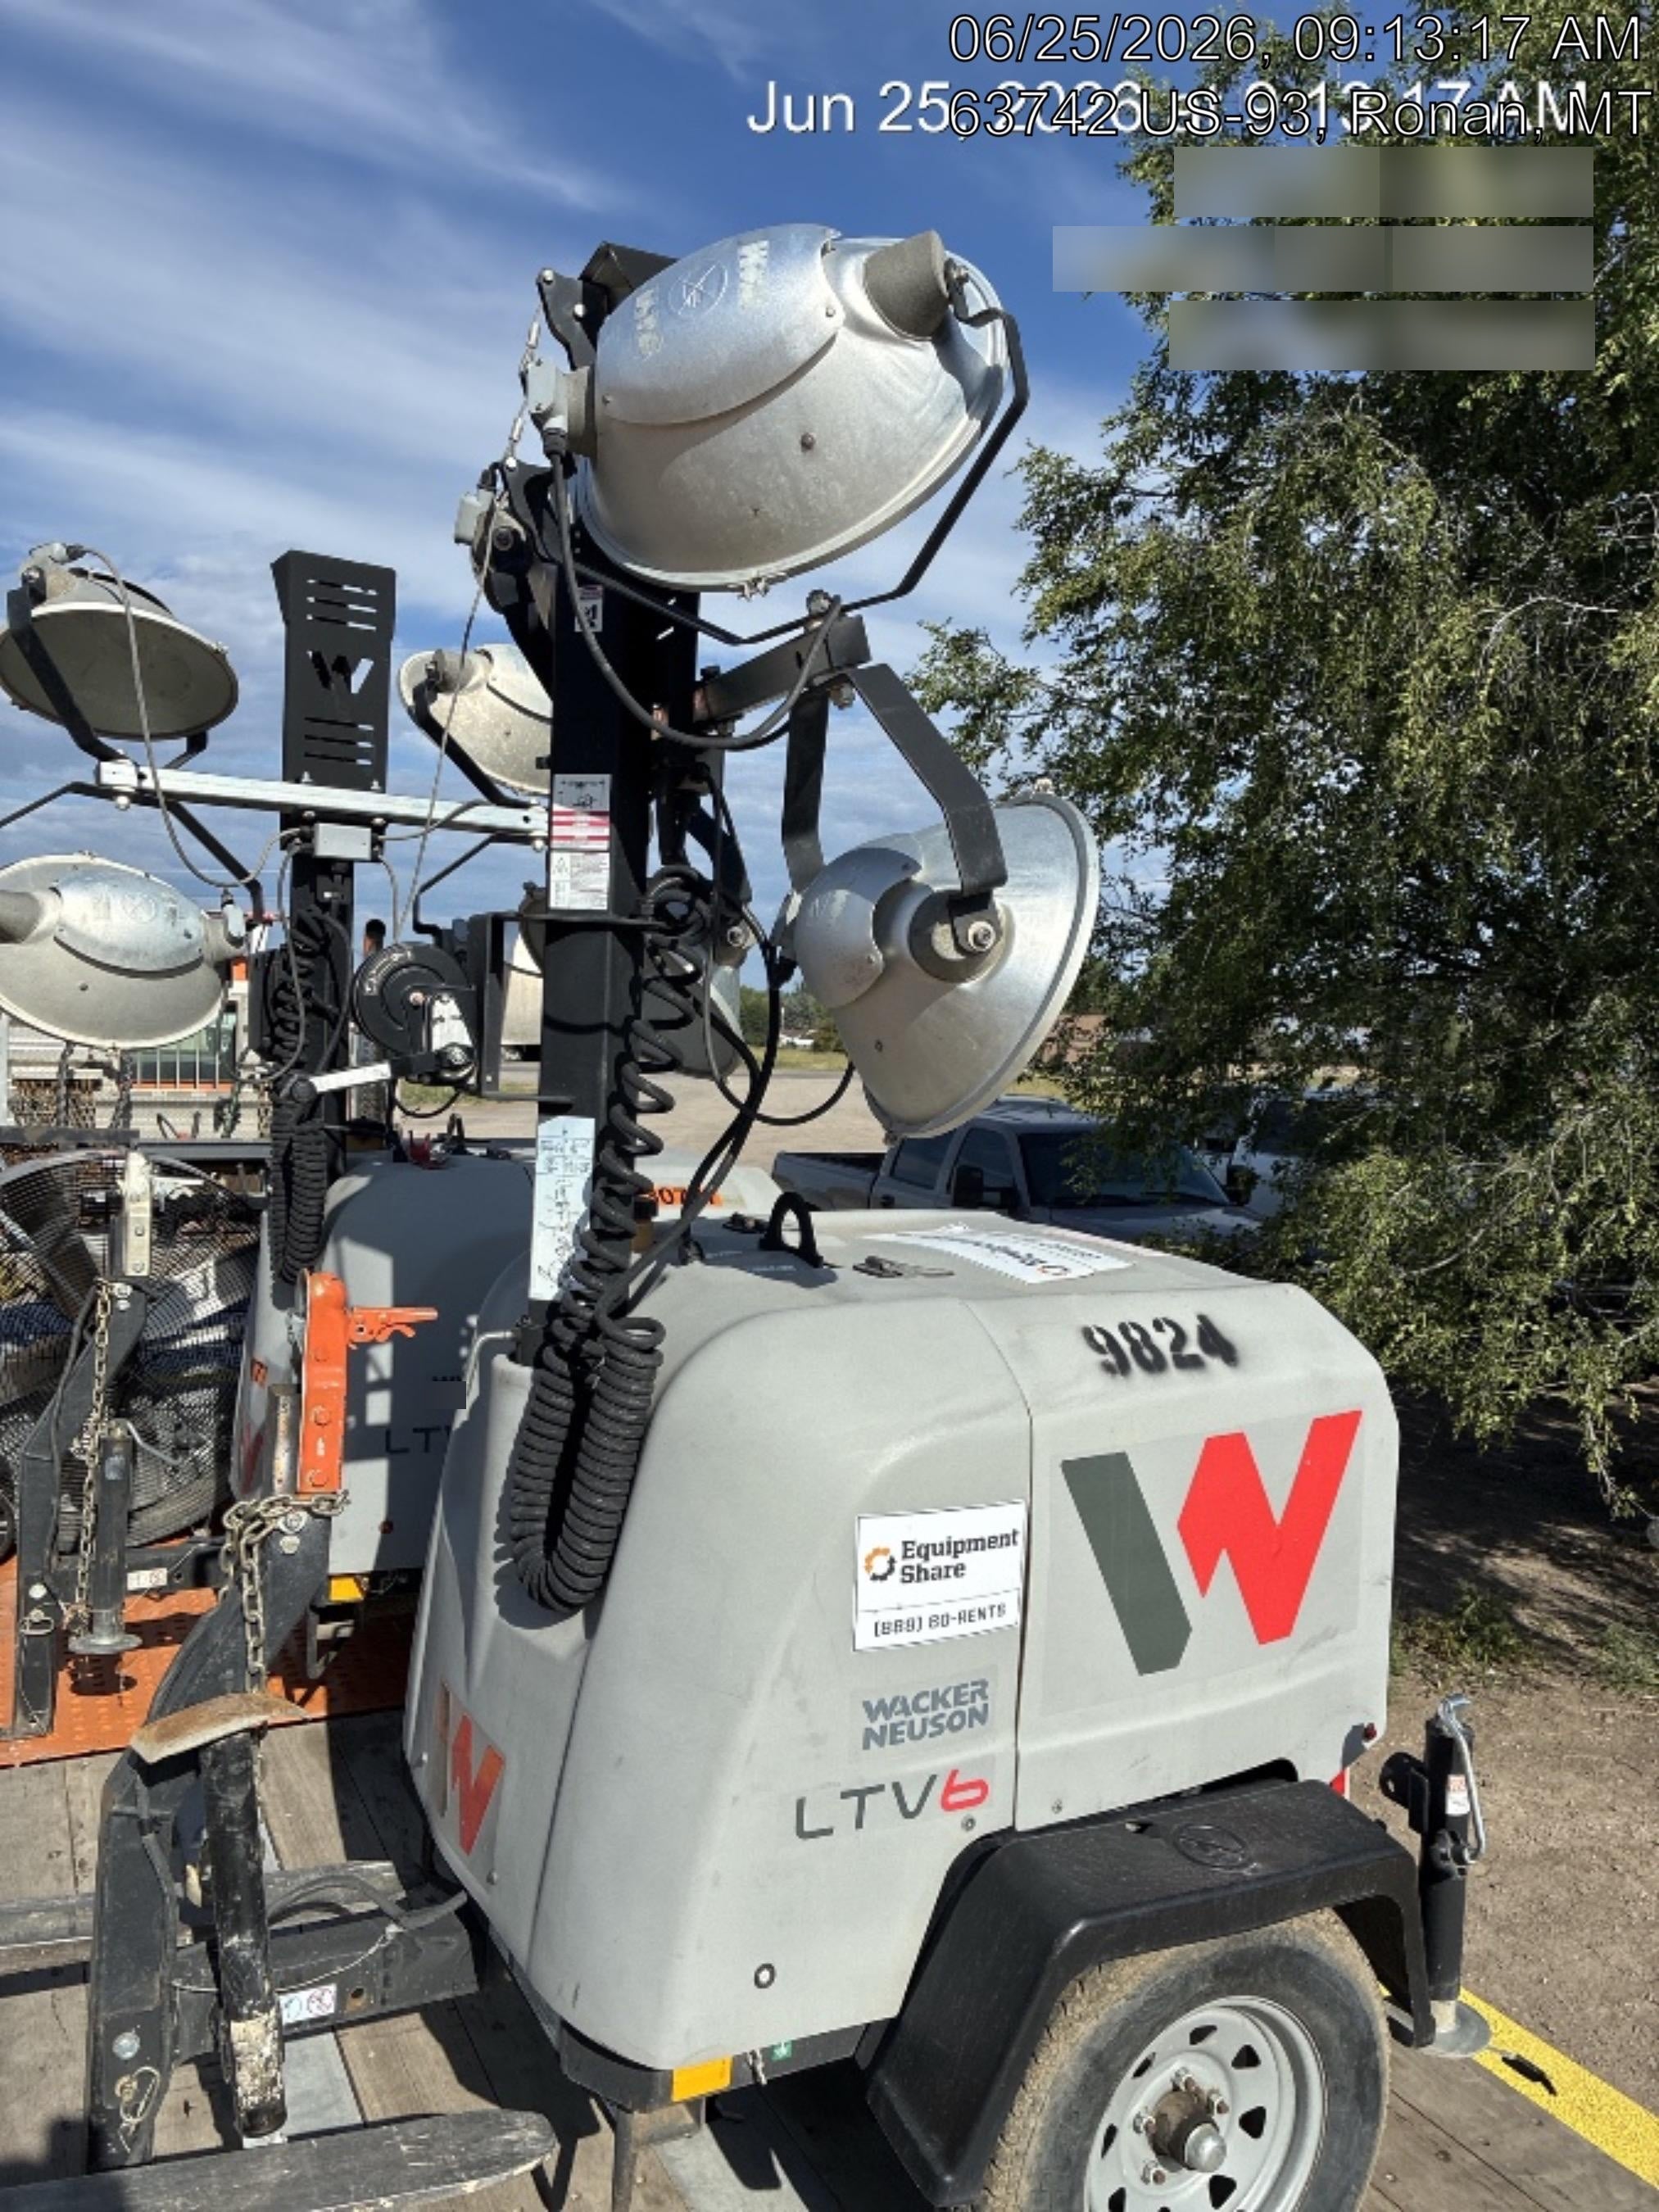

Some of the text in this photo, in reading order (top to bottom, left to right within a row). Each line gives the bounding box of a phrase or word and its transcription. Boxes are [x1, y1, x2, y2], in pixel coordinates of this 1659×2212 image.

[1081, 1313, 1239, 1378] 9824
[385, 1426, 452, 1454] LT
[901, 1528, 1019, 1563] Equipment
[900, 1562, 967, 1584] Share
[862, 1679, 990, 1724] WACKER
[862, 1702, 990, 1751] NEUSON
[796, 1768, 990, 1840] LTV6
